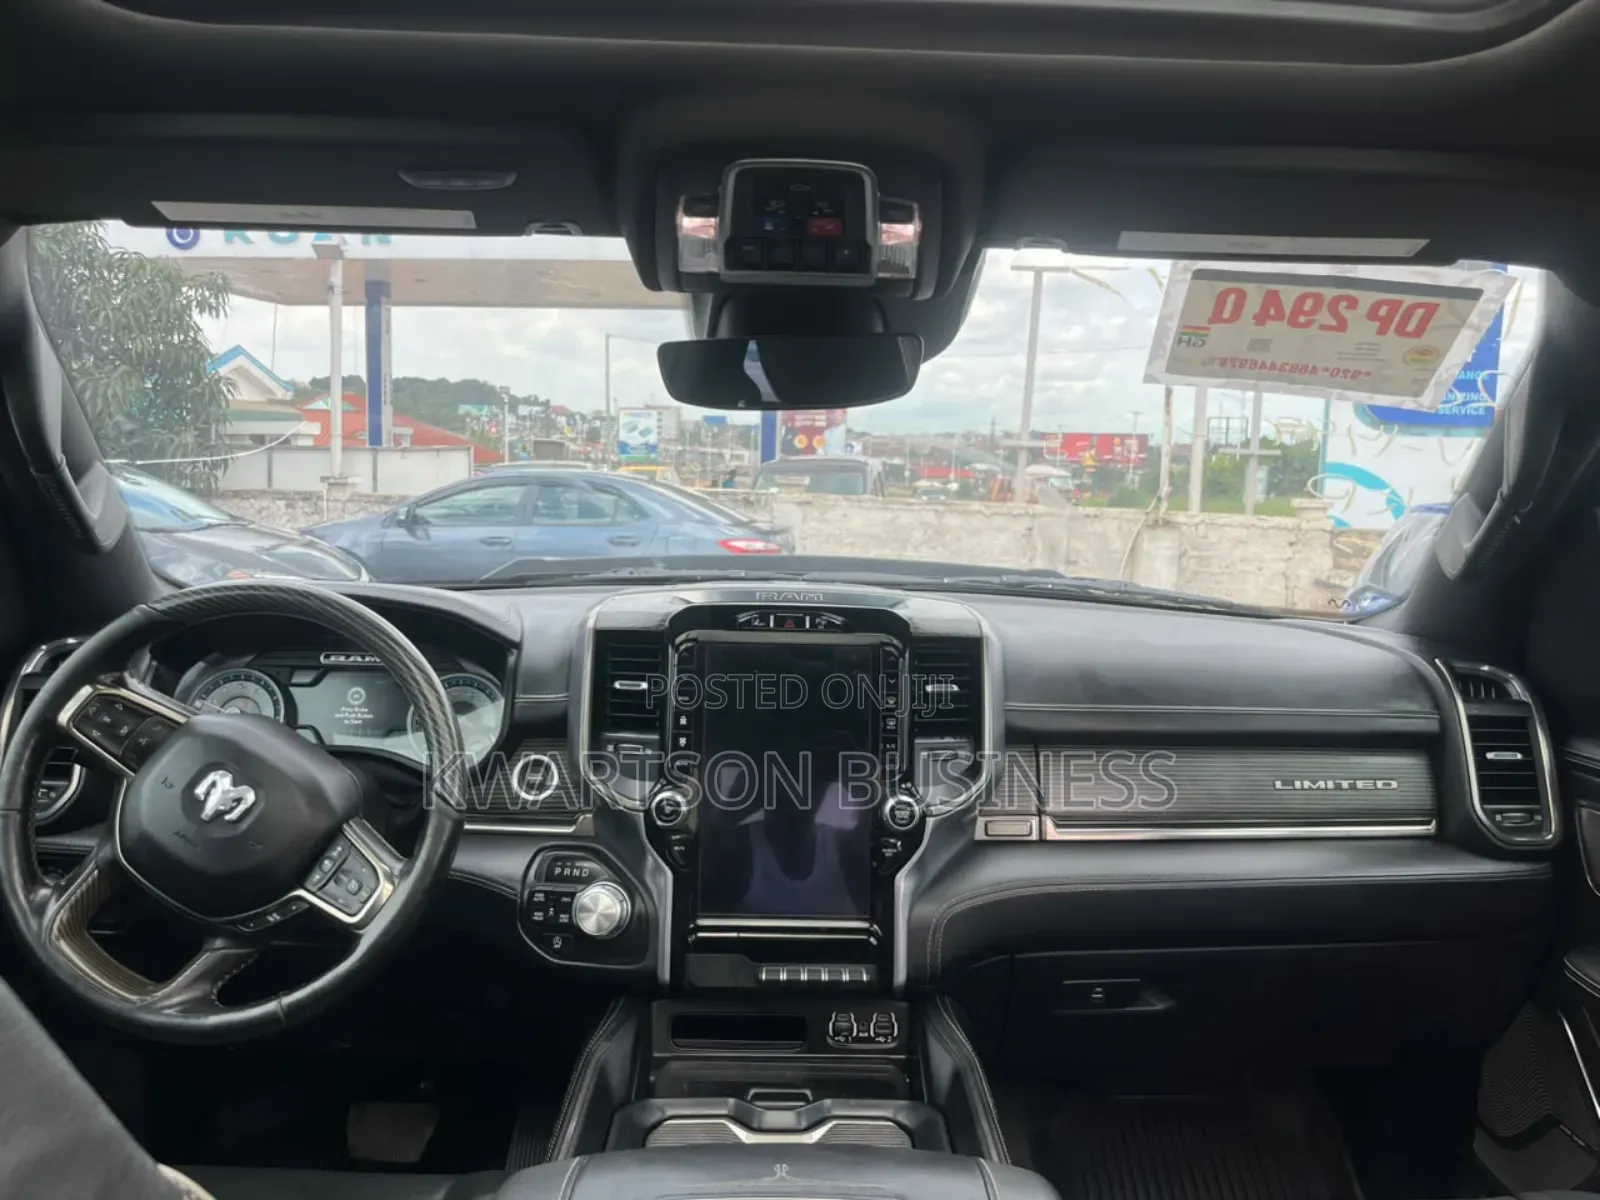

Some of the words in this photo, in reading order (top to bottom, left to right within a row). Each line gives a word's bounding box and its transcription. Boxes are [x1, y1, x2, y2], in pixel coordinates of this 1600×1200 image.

[1438, 406, 1486, 416] SERVICE
[755, 591, 824, 601] RAM
[1274, 779, 1399, 790] LIMITED
